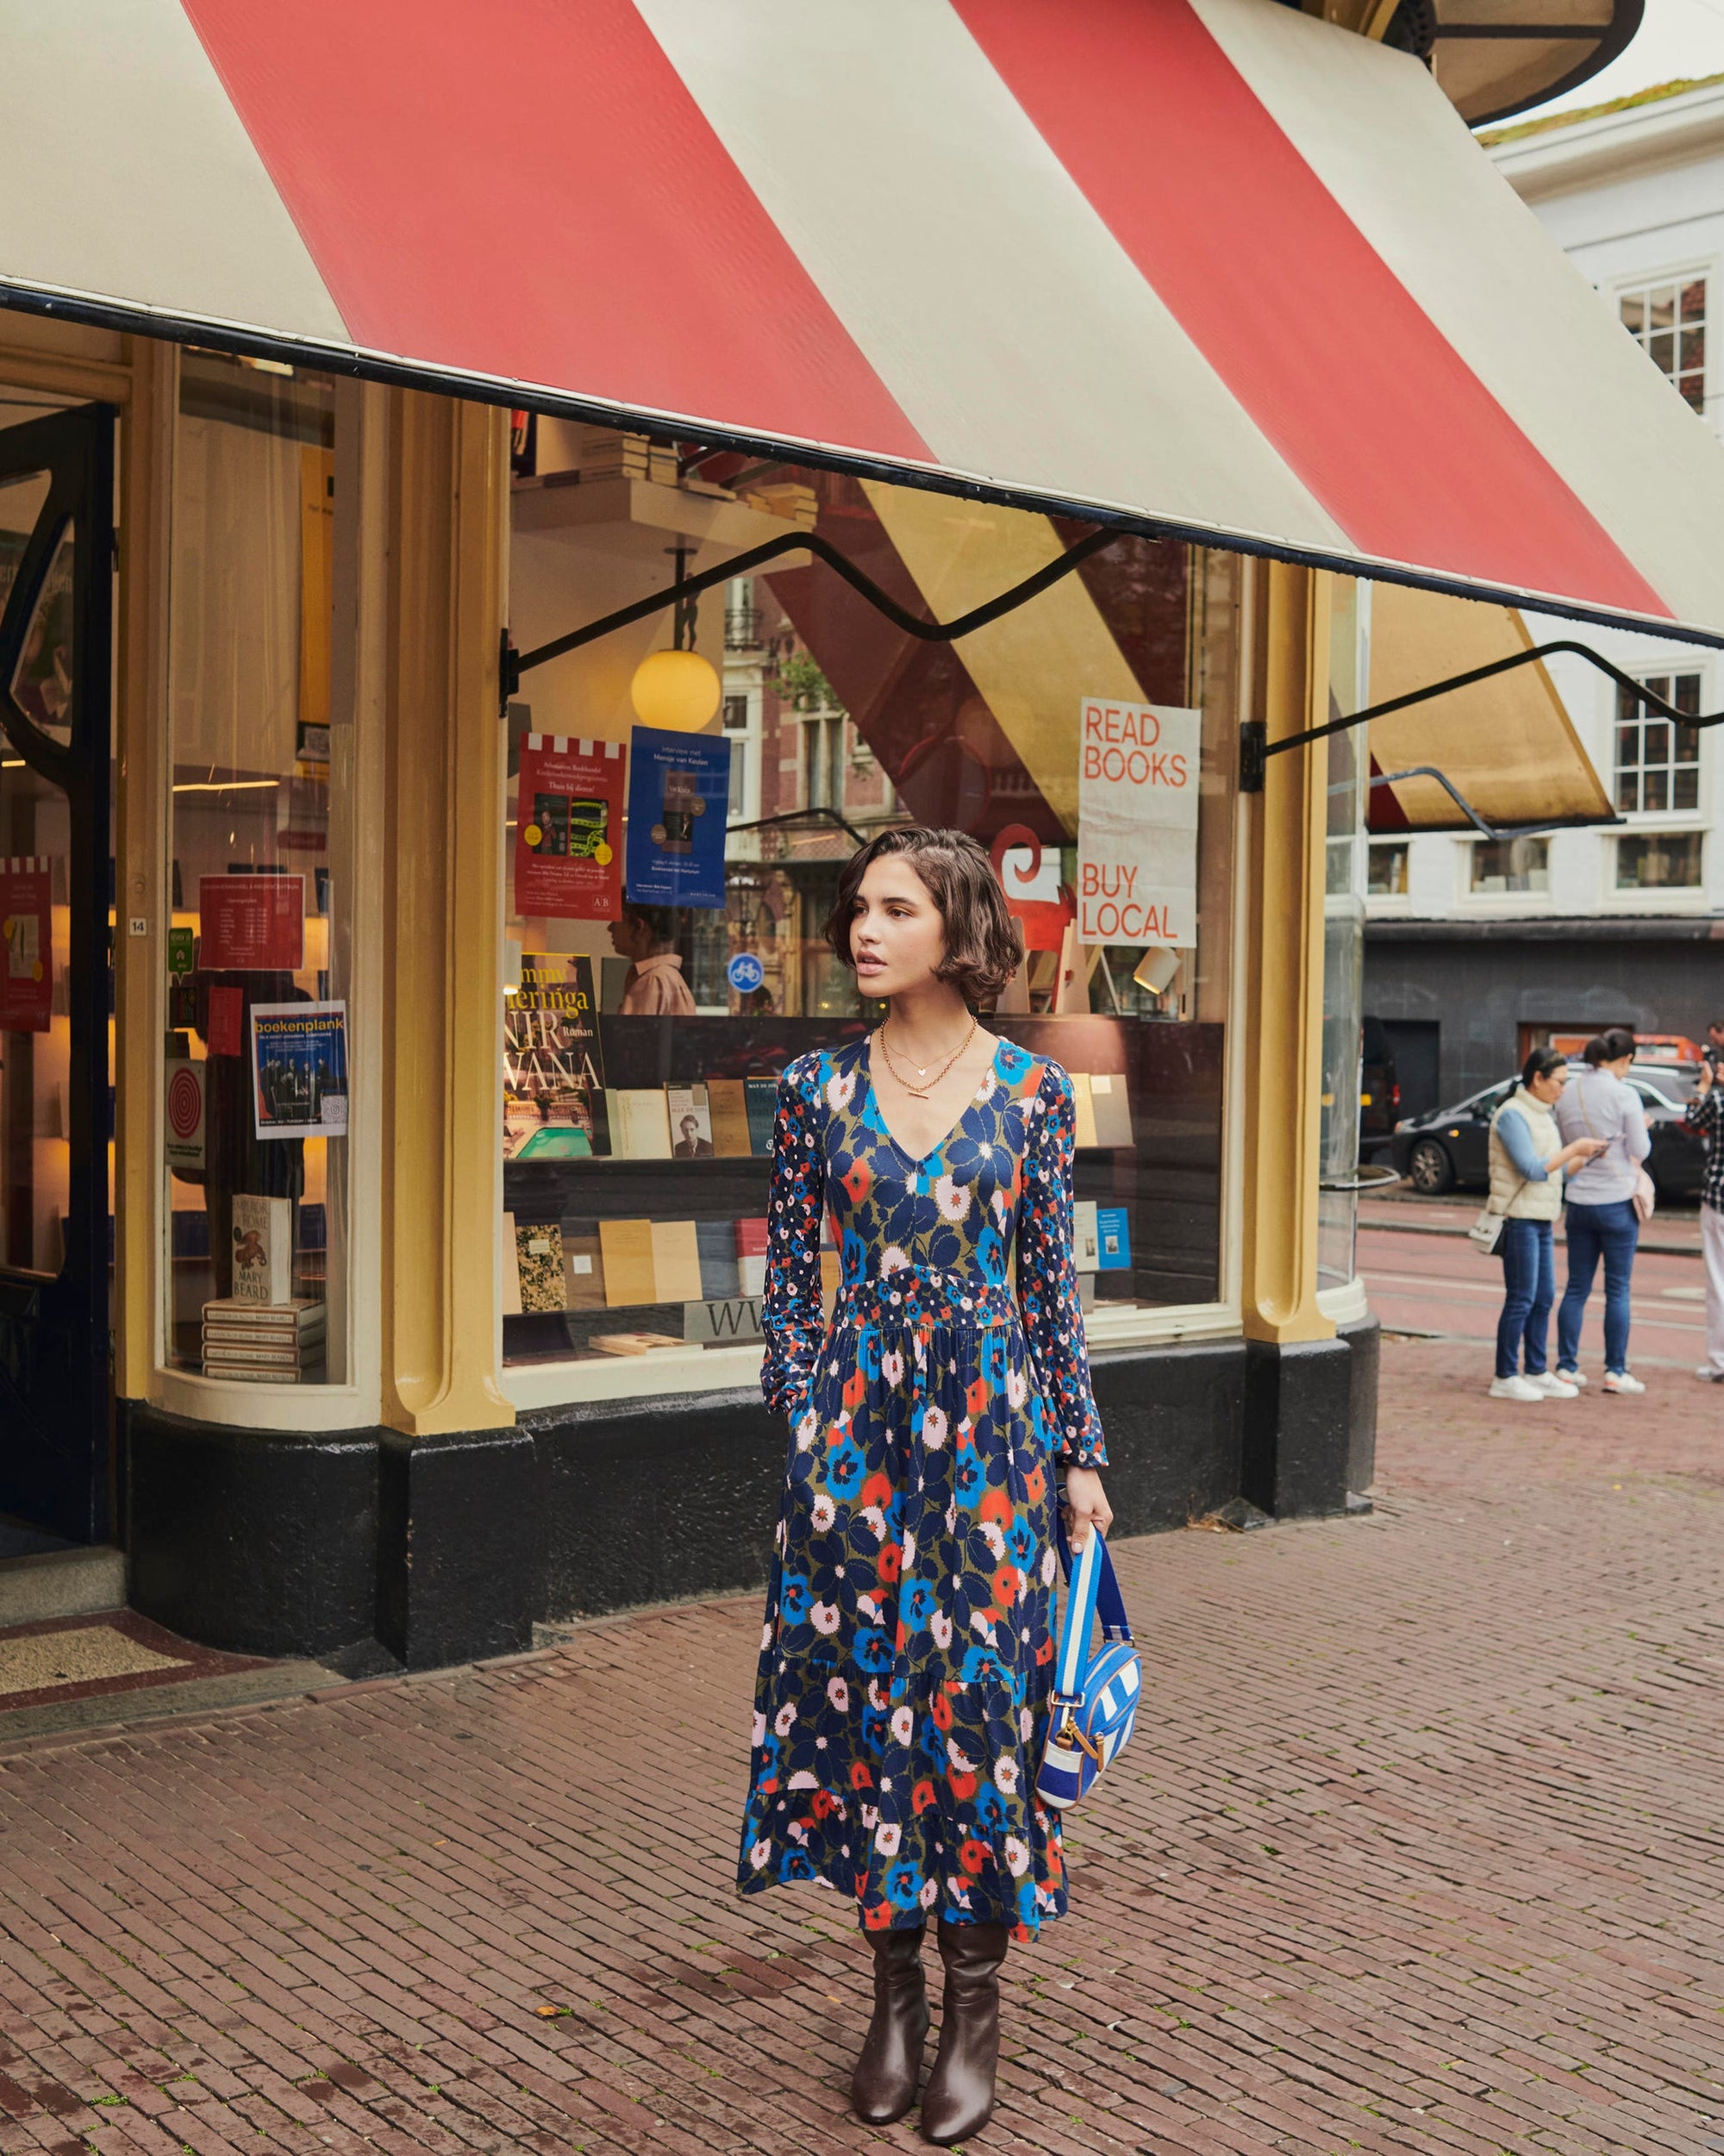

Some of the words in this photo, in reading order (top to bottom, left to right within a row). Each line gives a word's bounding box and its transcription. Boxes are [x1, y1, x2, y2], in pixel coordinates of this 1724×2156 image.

[1086, 706, 1160, 747] READ
[1084, 746, 1187, 787] BOOKS
[1083, 863, 1138, 898] BUY
[132, 922, 145, 932] 14
[1082, 902, 1178, 939] LOCAL
[522, 969, 566, 991] mmy
[508, 984, 590, 1019] ieringa
[255, 1017, 344, 1034] boekenplank
[563, 1026, 593, 1037] Roman
[240, 1271, 262, 1284] MARY
[234, 1282, 268, 1300] BEARD
